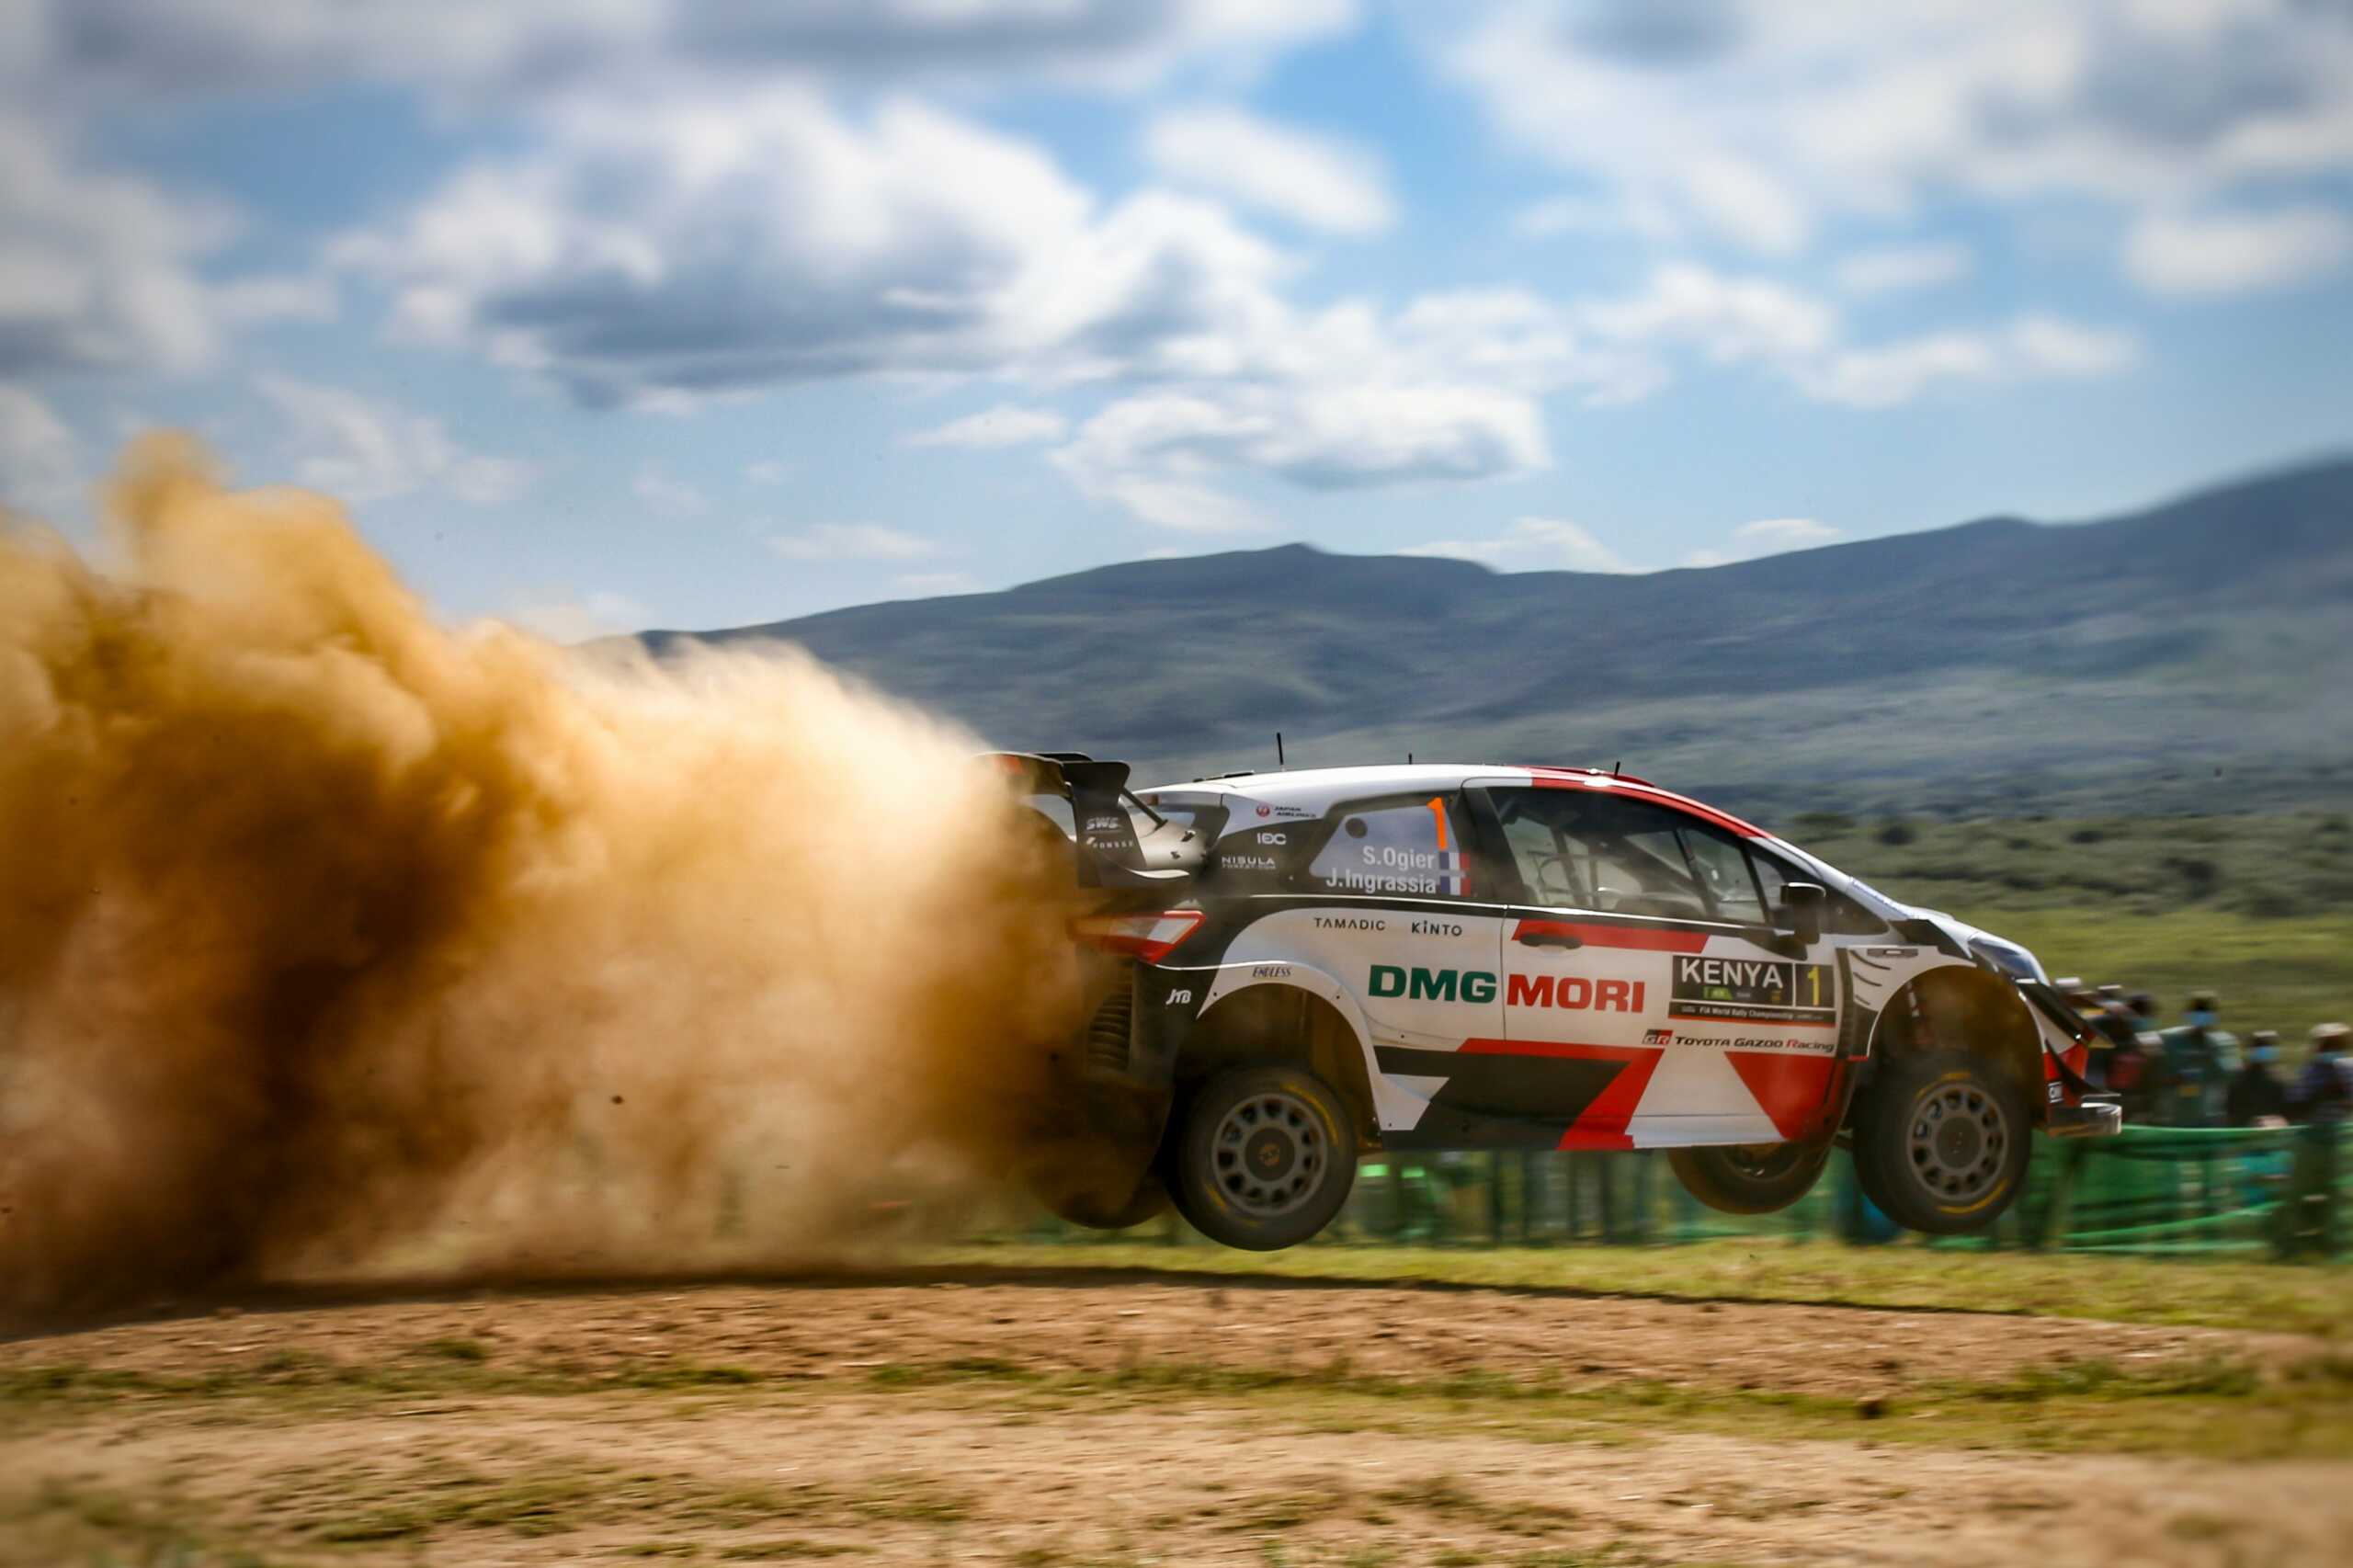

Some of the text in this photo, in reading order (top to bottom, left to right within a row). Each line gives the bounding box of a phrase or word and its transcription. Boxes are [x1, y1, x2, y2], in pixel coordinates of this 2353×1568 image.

[1426, 797, 1448, 850] 1
[1222, 856, 1276, 865] NISULA
[1363, 845, 1435, 870] S.Ogier
[1326, 868, 1437, 893] J.Ingrassia
[1314, 917, 1386, 931] TAMADIC
[1252, 966, 1291, 978] ENDLESS
[1681, 958, 1820, 1006] KENYA 1
[1165, 989, 1191, 1005] JTB
[1368, 965, 1644, 1014] DMG MORI
[1676, 1036, 1835, 1052] TOYOTA GAZOO Racing
